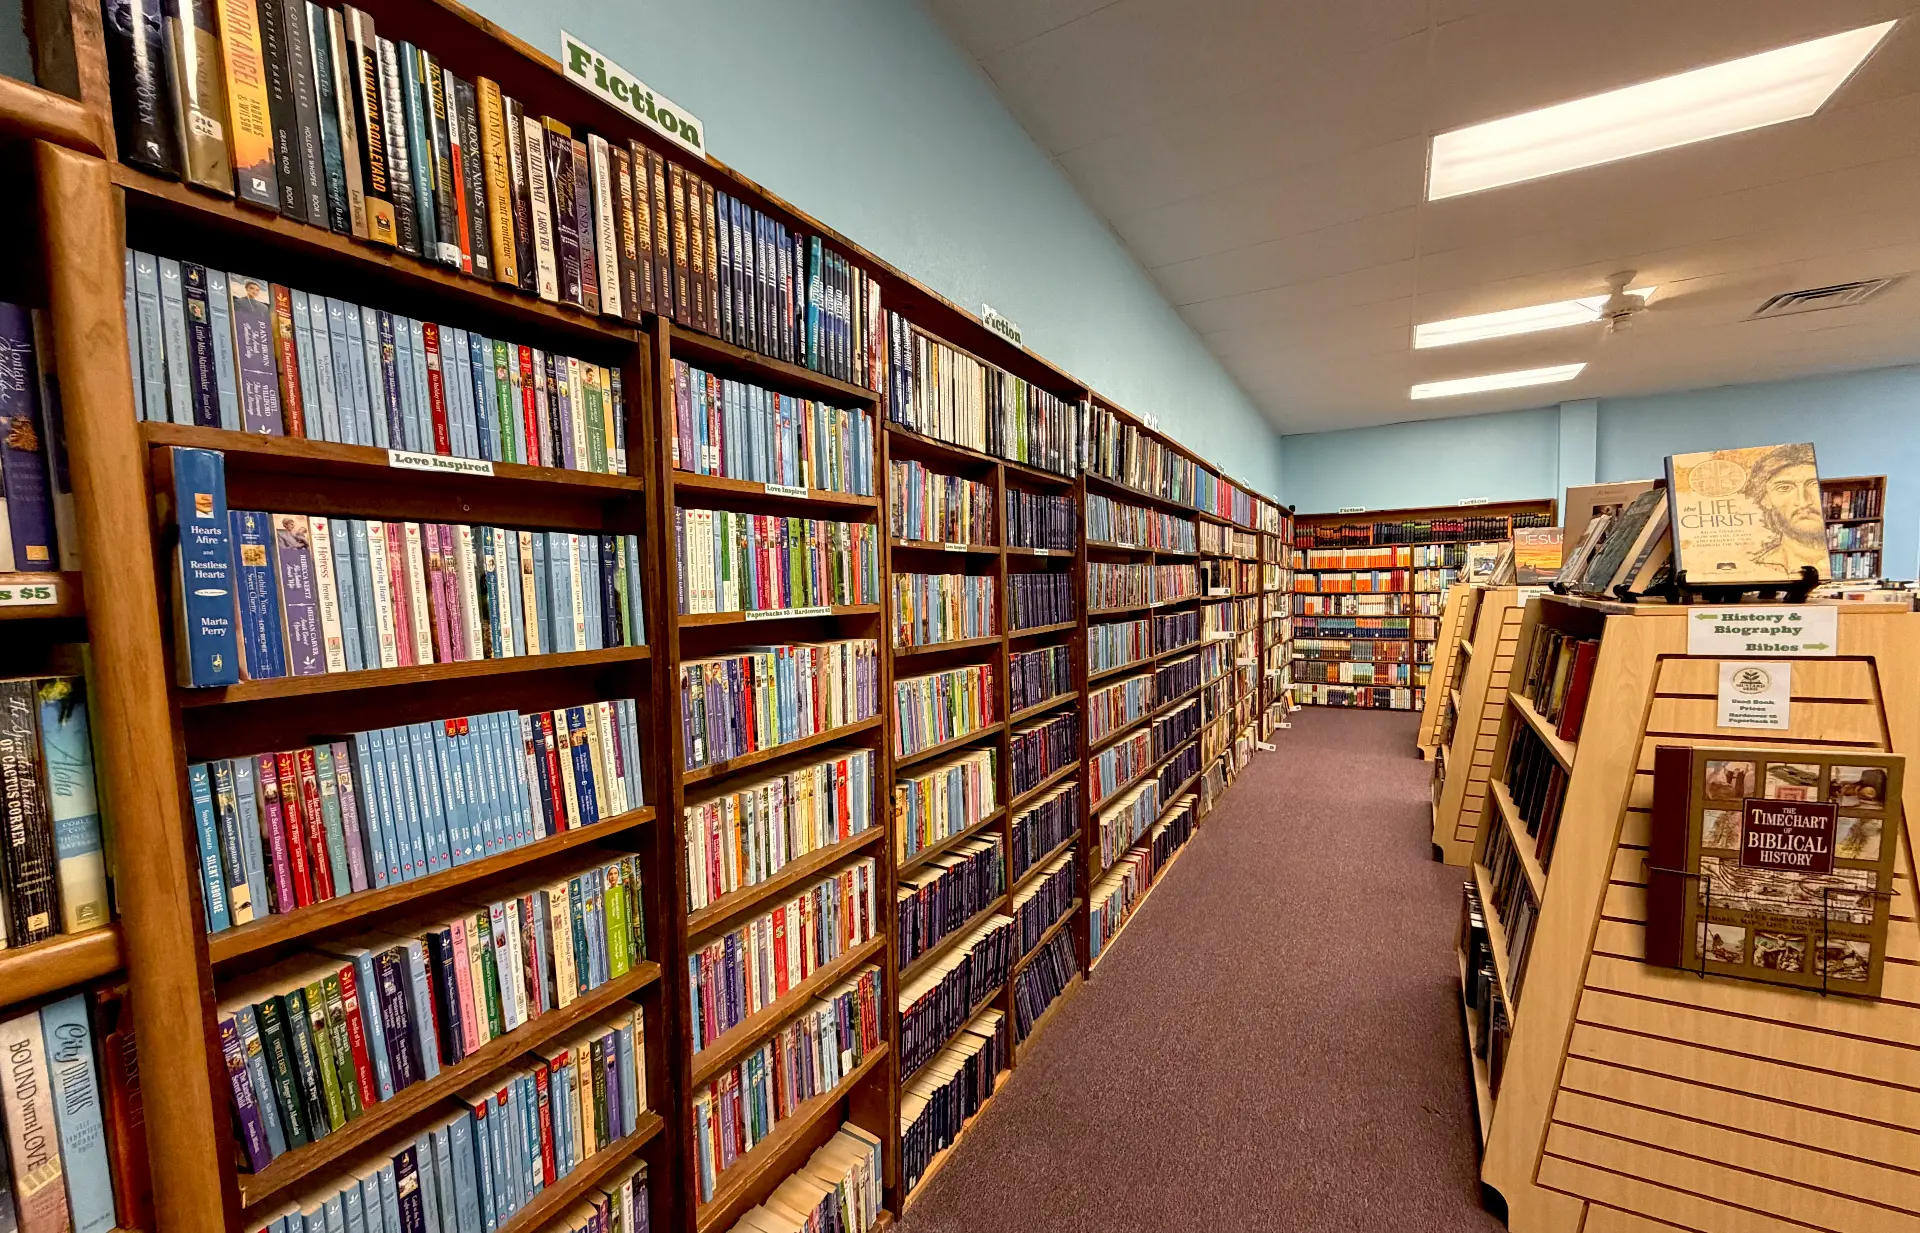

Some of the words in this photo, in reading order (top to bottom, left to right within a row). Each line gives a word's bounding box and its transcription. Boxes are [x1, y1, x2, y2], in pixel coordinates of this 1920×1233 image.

[230, 37, 259, 89] ANGEL
[264, 0, 277, 57] OURTNEY
[271, 63, 282, 100] BAKER
[289, 6, 303, 67] COURTNEY
[298, 73, 308, 108] BAKER
[361, 55, 378, 124] SALVATION
[566, 41, 701, 148] Fiction
[238, 102, 252, 133] WILSON
[249, 98, 264, 138] ANDREWS
[449, 112, 457, 138] ISLAND
[466, 106, 474, 121] THE
[279, 129, 288, 154] GRAVEL
[304, 126, 315, 161] HOLLOWS
[467, 122, 480, 155] BOOK
[510, 114, 519, 145] CROWN
[486, 85, 506, 190] ILLUMINATED
[498, 195, 507, 215] matt
[527, 135, 540, 153] THE
[282, 155, 290, 174] ROAD
[368, 124, 387, 193] BOULEVARD
[472, 158, 480, 172] OF
[515, 155, 525, 187] THORNS
[308, 161, 318, 187] WHISPER
[528, 154, 546, 205] ILLUMINATI
[620, 173, 632, 199] BOOK
[635, 165, 648, 194] BOOK
[655, 173, 666, 201] BOOK
[311, 195, 319, 211] BOOK
[473, 173, 485, 213] NAMES
[474, 216, 485, 249] BRIGGS
[517, 199, 530, 245] BROUWER
[536, 209, 549, 236] LARRY
[579, 204, 590, 235] ENDS
[602, 215, 613, 252] WINNER
[637, 200, 651, 252] MYSTERIES
[656, 209, 669, 258] MYSTERIES
[623, 210, 636, 261] MYSTERIES
[719, 219, 729, 257] HARBINGER
[732, 225, 741, 263] HARBINGER
[582, 247, 597, 287] EARTH
[606, 252, 614, 275] TAKE
[608, 275, 616, 292] ALL
[812, 275, 821, 307] ORACLE
[826, 285, 834, 316] ORACLE
[9, 338, 32, 392] Montana
[199, 355, 209, 391] Matchmaker
[395, 454, 430, 466] Love
[432, 458, 490, 474] Inspired
[767, 485, 780, 493] Love
[782, 487, 806, 496] Inspired
[1681, 513, 1757, 528] CHRIST
[1698, 499, 1736, 515] LIFE
[191, 526, 222, 535] Hearts
[196, 535, 218, 544] Afire
[190, 560, 228, 569] Restless
[195, 570, 225, 579] Hearts
[300, 554, 309, 578] REBECCA
[318, 546, 329, 579] Heiress
[375, 556, 385, 585] Forgiving
[20, 587, 52, 600] $5
[247, 573, 255, 594] Sweet
[257, 571, 267, 598] Faithfully
[303, 579, 311, 599] KERTZ
[322, 584, 330, 602] Irene
[259, 599, 267, 615] Yours
[307, 606, 315, 629] MEGHAN
[325, 602, 334, 622] Brand
[747, 611, 782, 619] Paperbacks
[1721, 613, 1784, 623] History
[201, 617, 228, 626] Marta
[202, 627, 227, 636] Perry
[1714, 626, 1802, 636] Biography
[310, 629, 319, 656] CARVER
[0, 738, 13, 751] OF
[3, 721, 33, 776] Spinster
[21, 776, 36, 816] Brides
[3, 752, 20, 799] CACTUS
[44, 734, 88, 797] Aloha
[9, 801, 26, 848] CORNER
[1752, 809, 1828, 829] TIMECHART
[1748, 832, 1827, 853] BIBLICAL
[208, 854, 219, 879] SILENT
[1760, 850, 1813, 865] HISTORY
[211, 880, 224, 915] SABOTAGE
[54, 1023, 88, 1063] City
[9, 1037, 37, 1099] BOUND
[61, 1061, 94, 1116] DREAMS
[272, 1038, 284, 1059] LYNETTE
[283, 1079, 292, 1099] Danger
[289, 1111, 300, 1136] Mountain
[22, 1099, 37, 1125] WITH
[23, 1125, 48, 1172] LOVE
